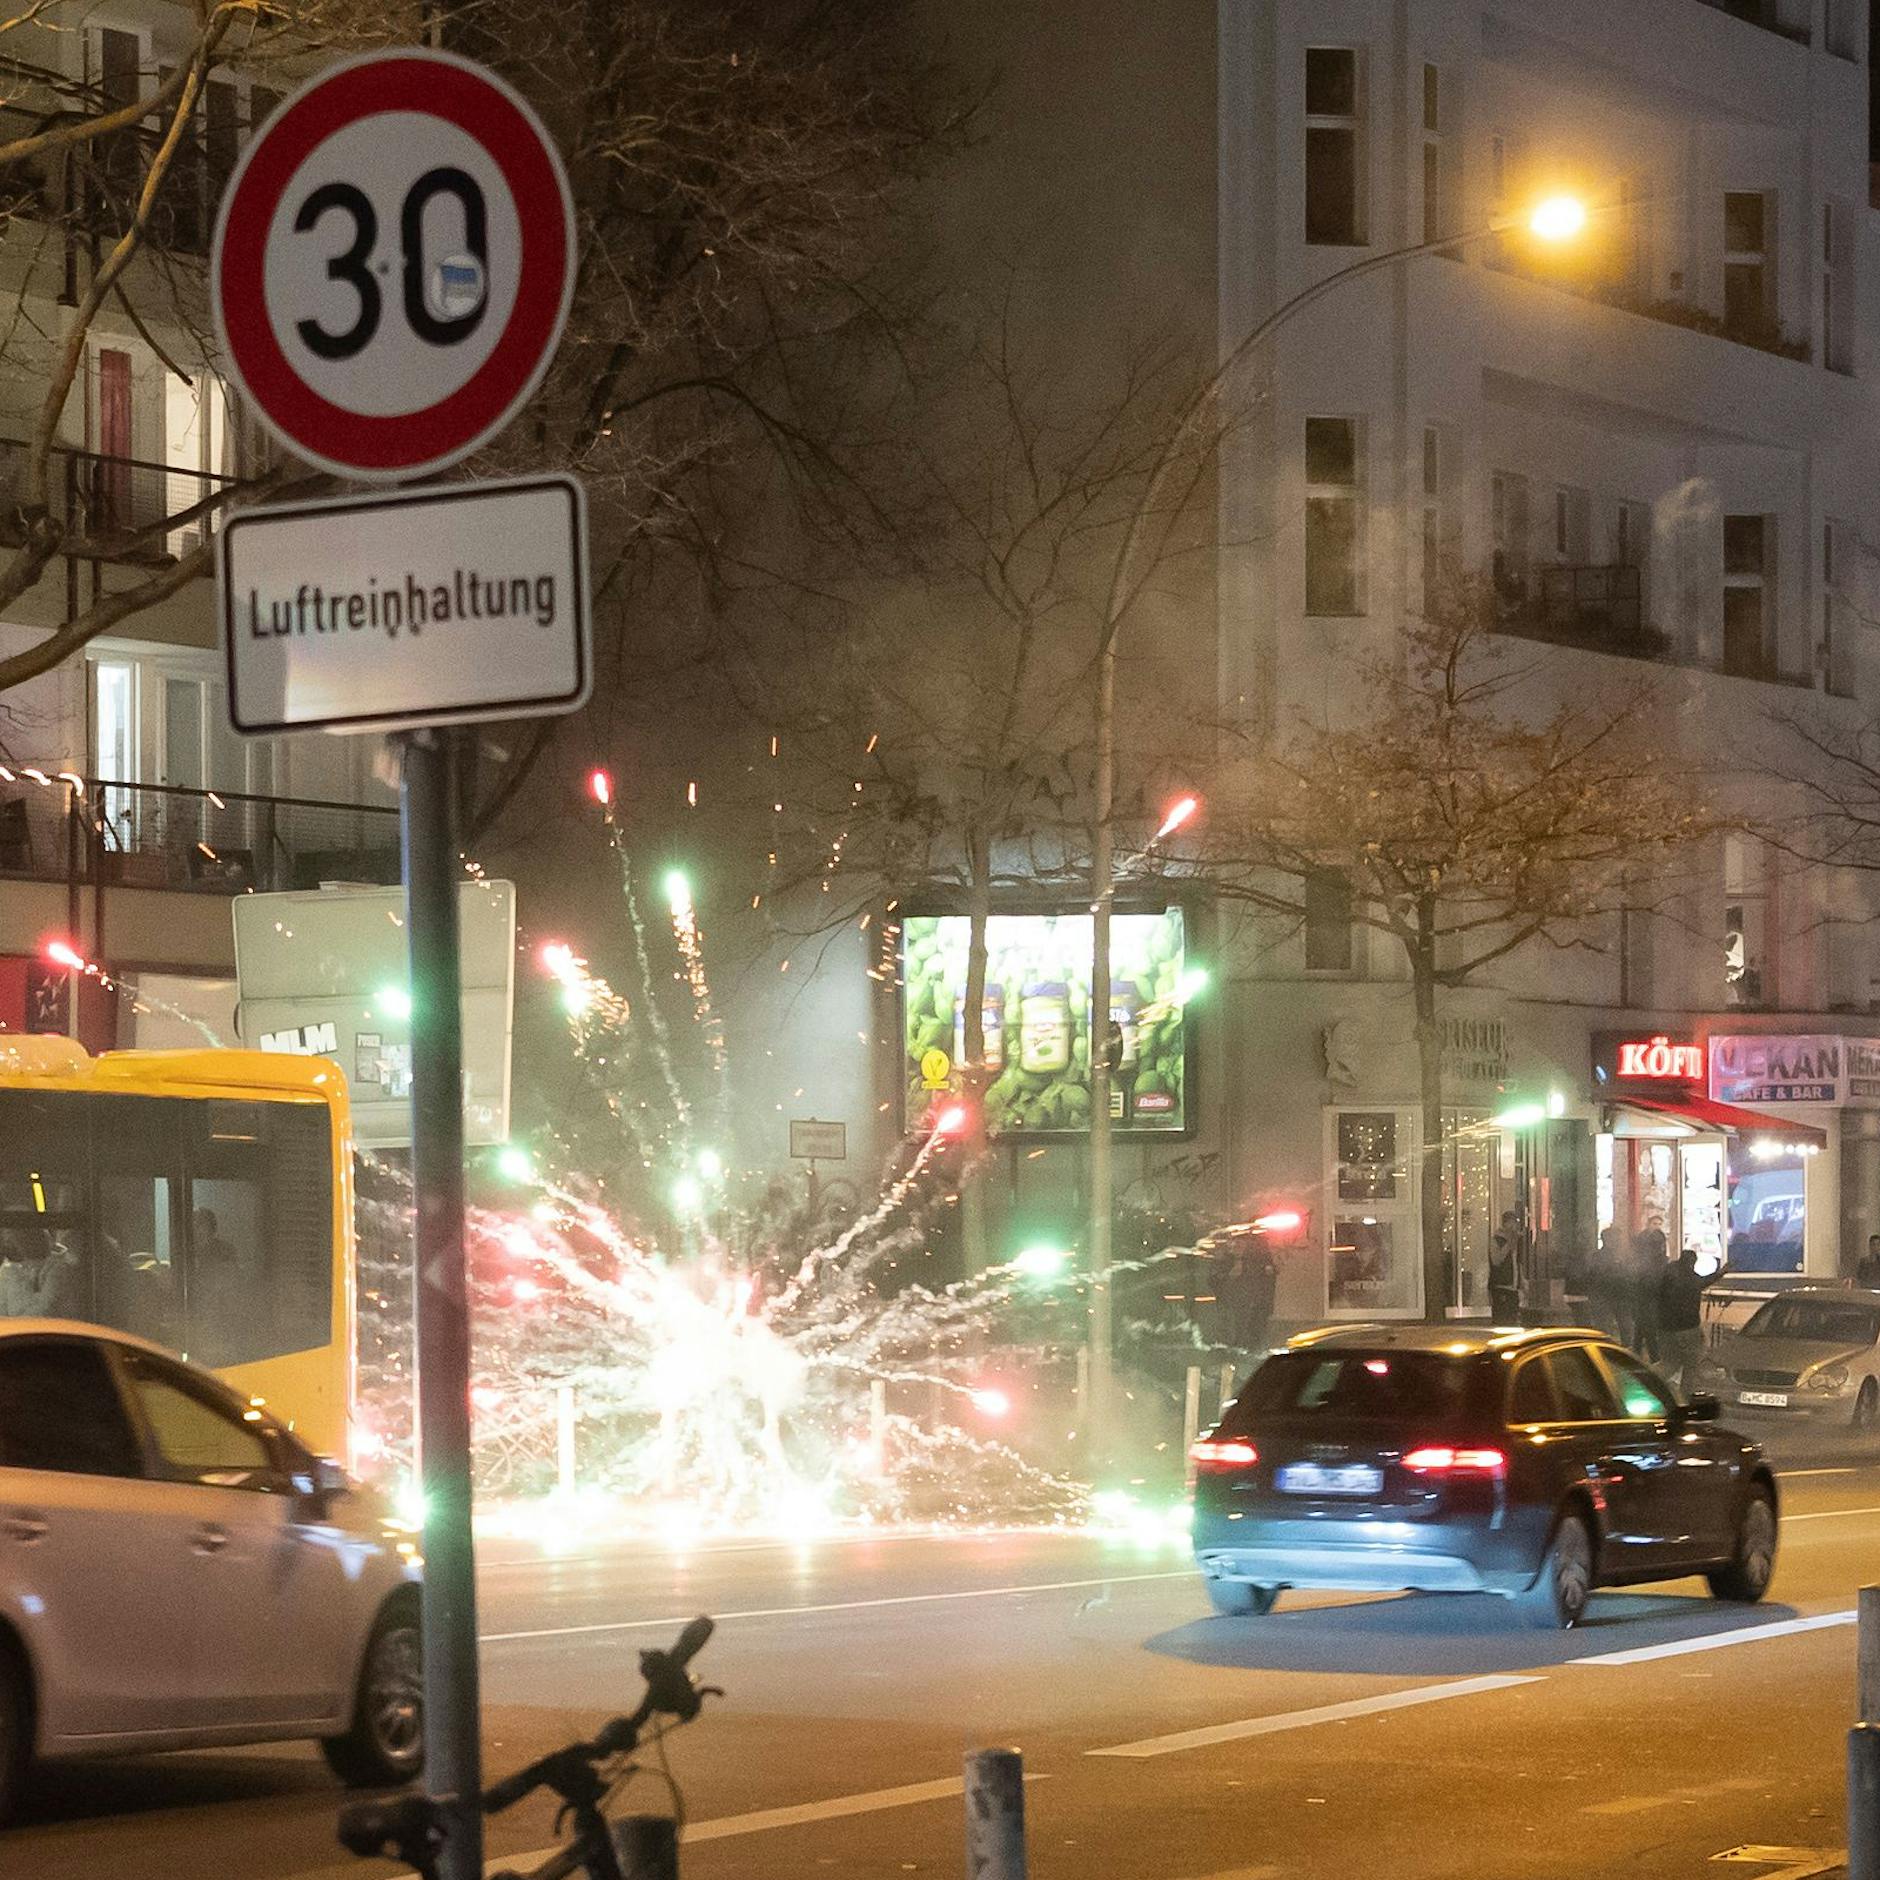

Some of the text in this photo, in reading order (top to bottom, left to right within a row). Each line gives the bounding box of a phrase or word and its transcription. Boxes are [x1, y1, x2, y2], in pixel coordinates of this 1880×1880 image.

[294, 167, 487, 360] 30
[250, 569, 556, 639] Luftreinhaltung
[1776, 1086, 1786, 1099] &
[1792, 1086, 1823, 1099] BAR
